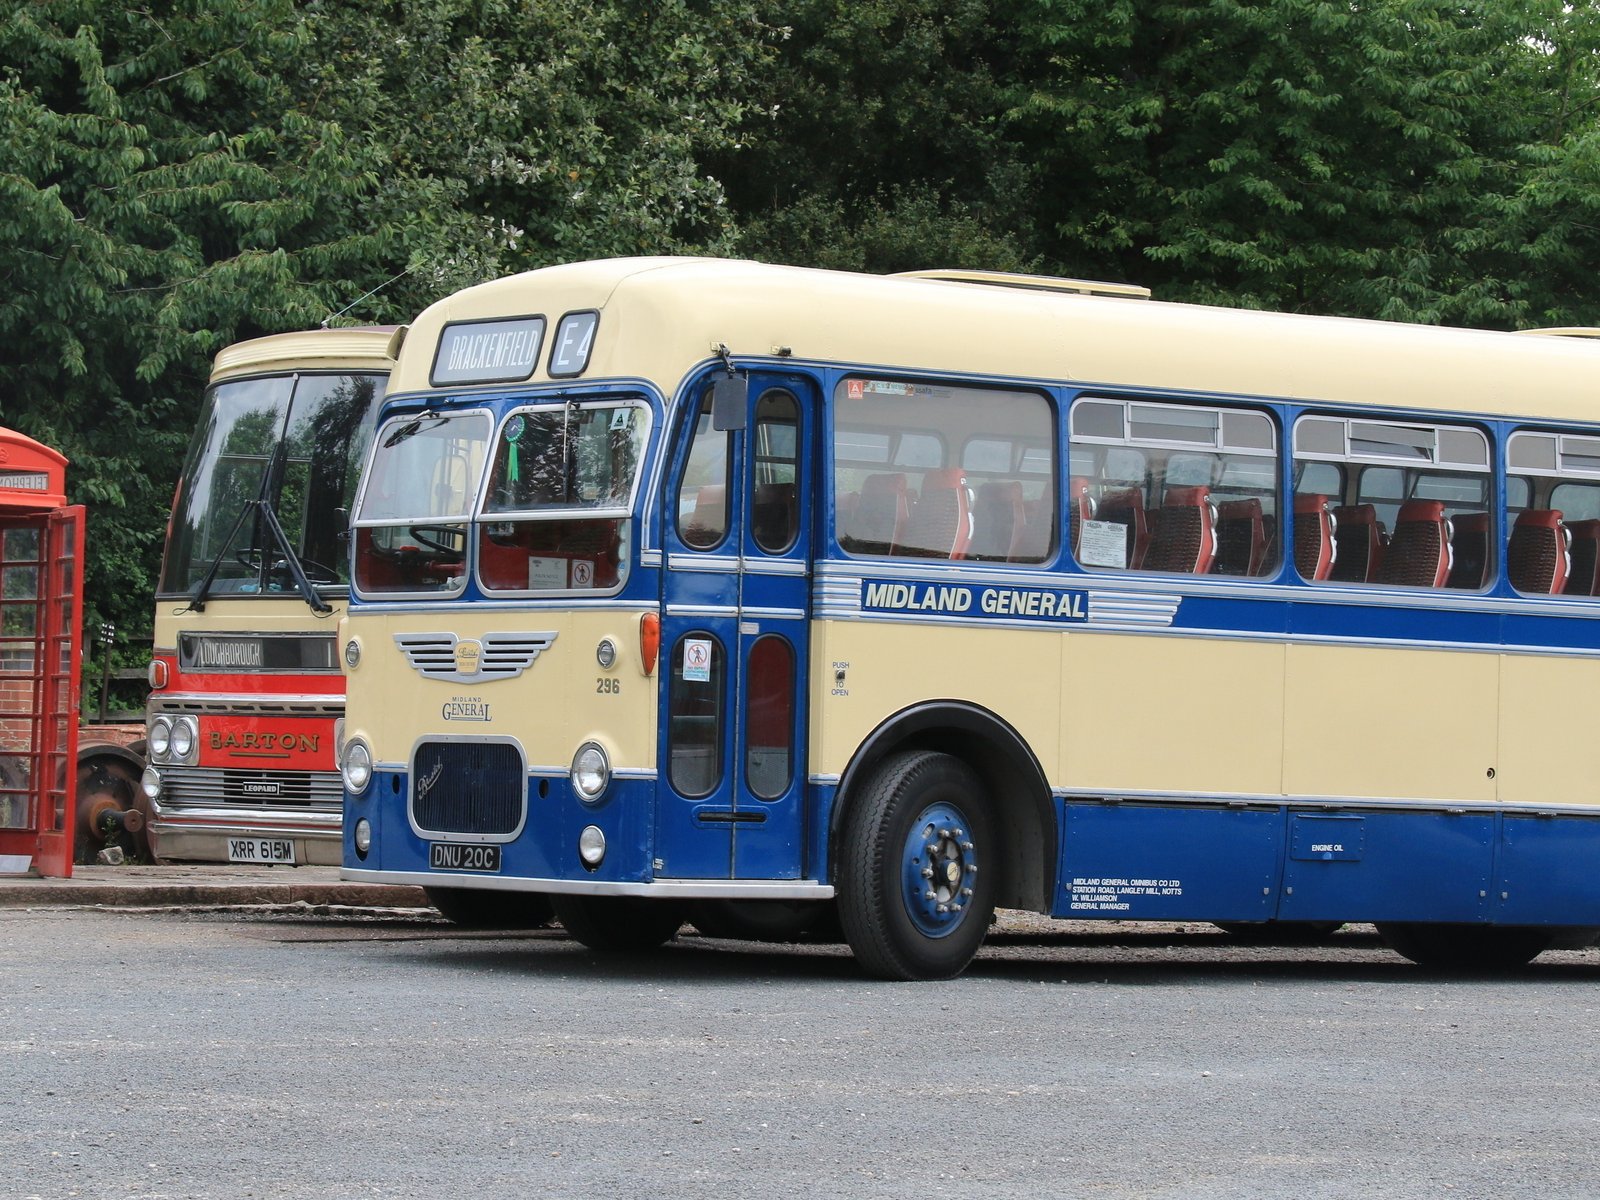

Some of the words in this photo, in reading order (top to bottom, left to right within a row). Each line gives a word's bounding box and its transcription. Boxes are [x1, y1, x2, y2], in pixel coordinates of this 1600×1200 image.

[448, 330, 539, 370] BRACKENFIELD
[865, 583, 972, 612] MIDLAND
[981, 588, 1085, 618] GENERAL
[200, 642, 261, 666] LOUGHBOROUGH
[832, 661, 850, 669] PUSH
[596, 678, 620, 694] 296
[442, 702, 492, 722] GENERAL
[210, 731, 319, 752] BARTON
[244, 784, 277, 793] LEOPARD
[231, 840, 255, 858] XRR
[260, 841, 292, 859] 615M
[434, 845, 461, 866] DNU
[464, 847, 494, 868] 20C
[1311, 844, 1333, 852] ENGINE
[1333, 844, 1344, 852] OIL
[1072, 886, 1096, 894] STATION
[1097, 887, 1115, 895] ROAD,
[1116, 887, 1145, 895] LANGLEY
[1073, 878, 1100, 886] MIDLAND
[1101, 878, 1130, 886] GENERAL
[1130, 879, 1157, 887] OMNIBUS
[1070, 902, 1098, 910] GENERAL
